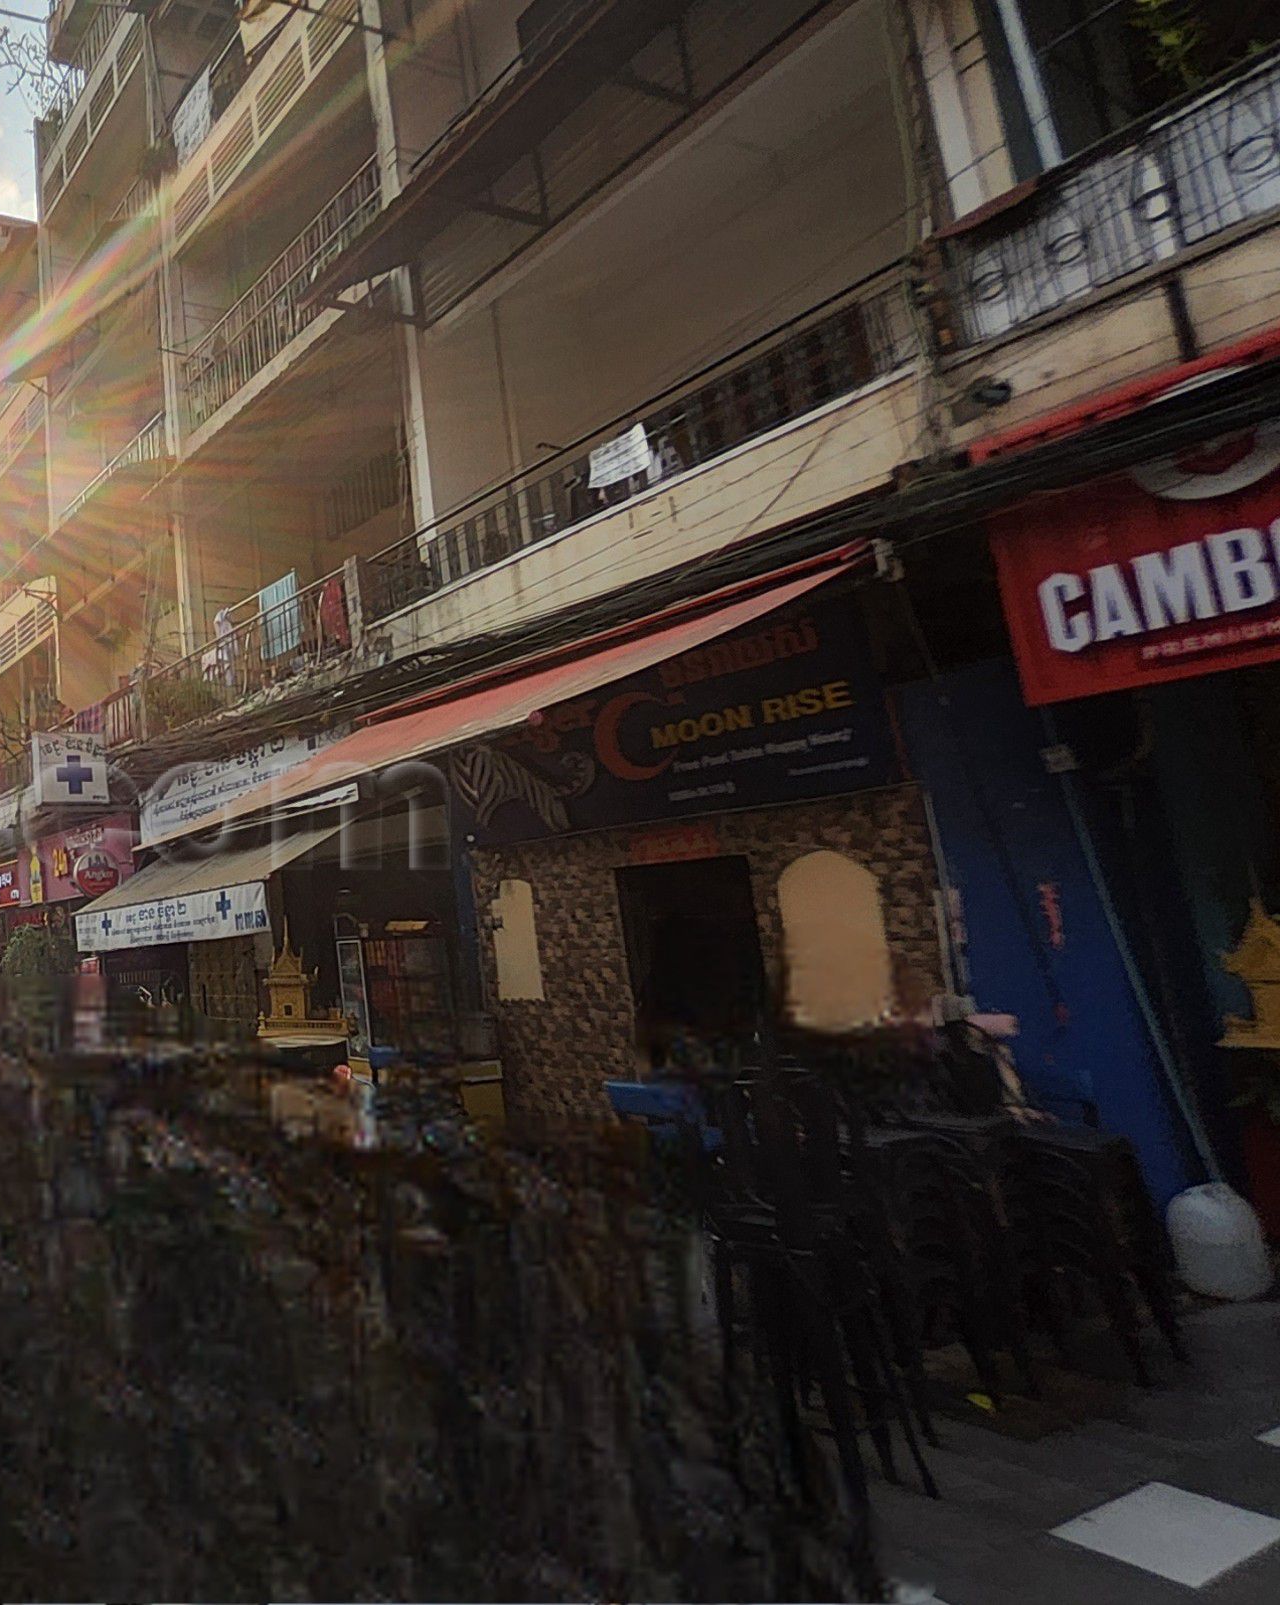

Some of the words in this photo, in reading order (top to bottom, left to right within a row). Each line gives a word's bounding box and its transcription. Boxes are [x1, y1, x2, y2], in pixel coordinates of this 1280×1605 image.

[1037, 513, 1280, 652] CAMB
[650, 704, 754, 749] MOON
[761, 679, 854, 724] RISE
[84, 870, 114, 881] Angkor
